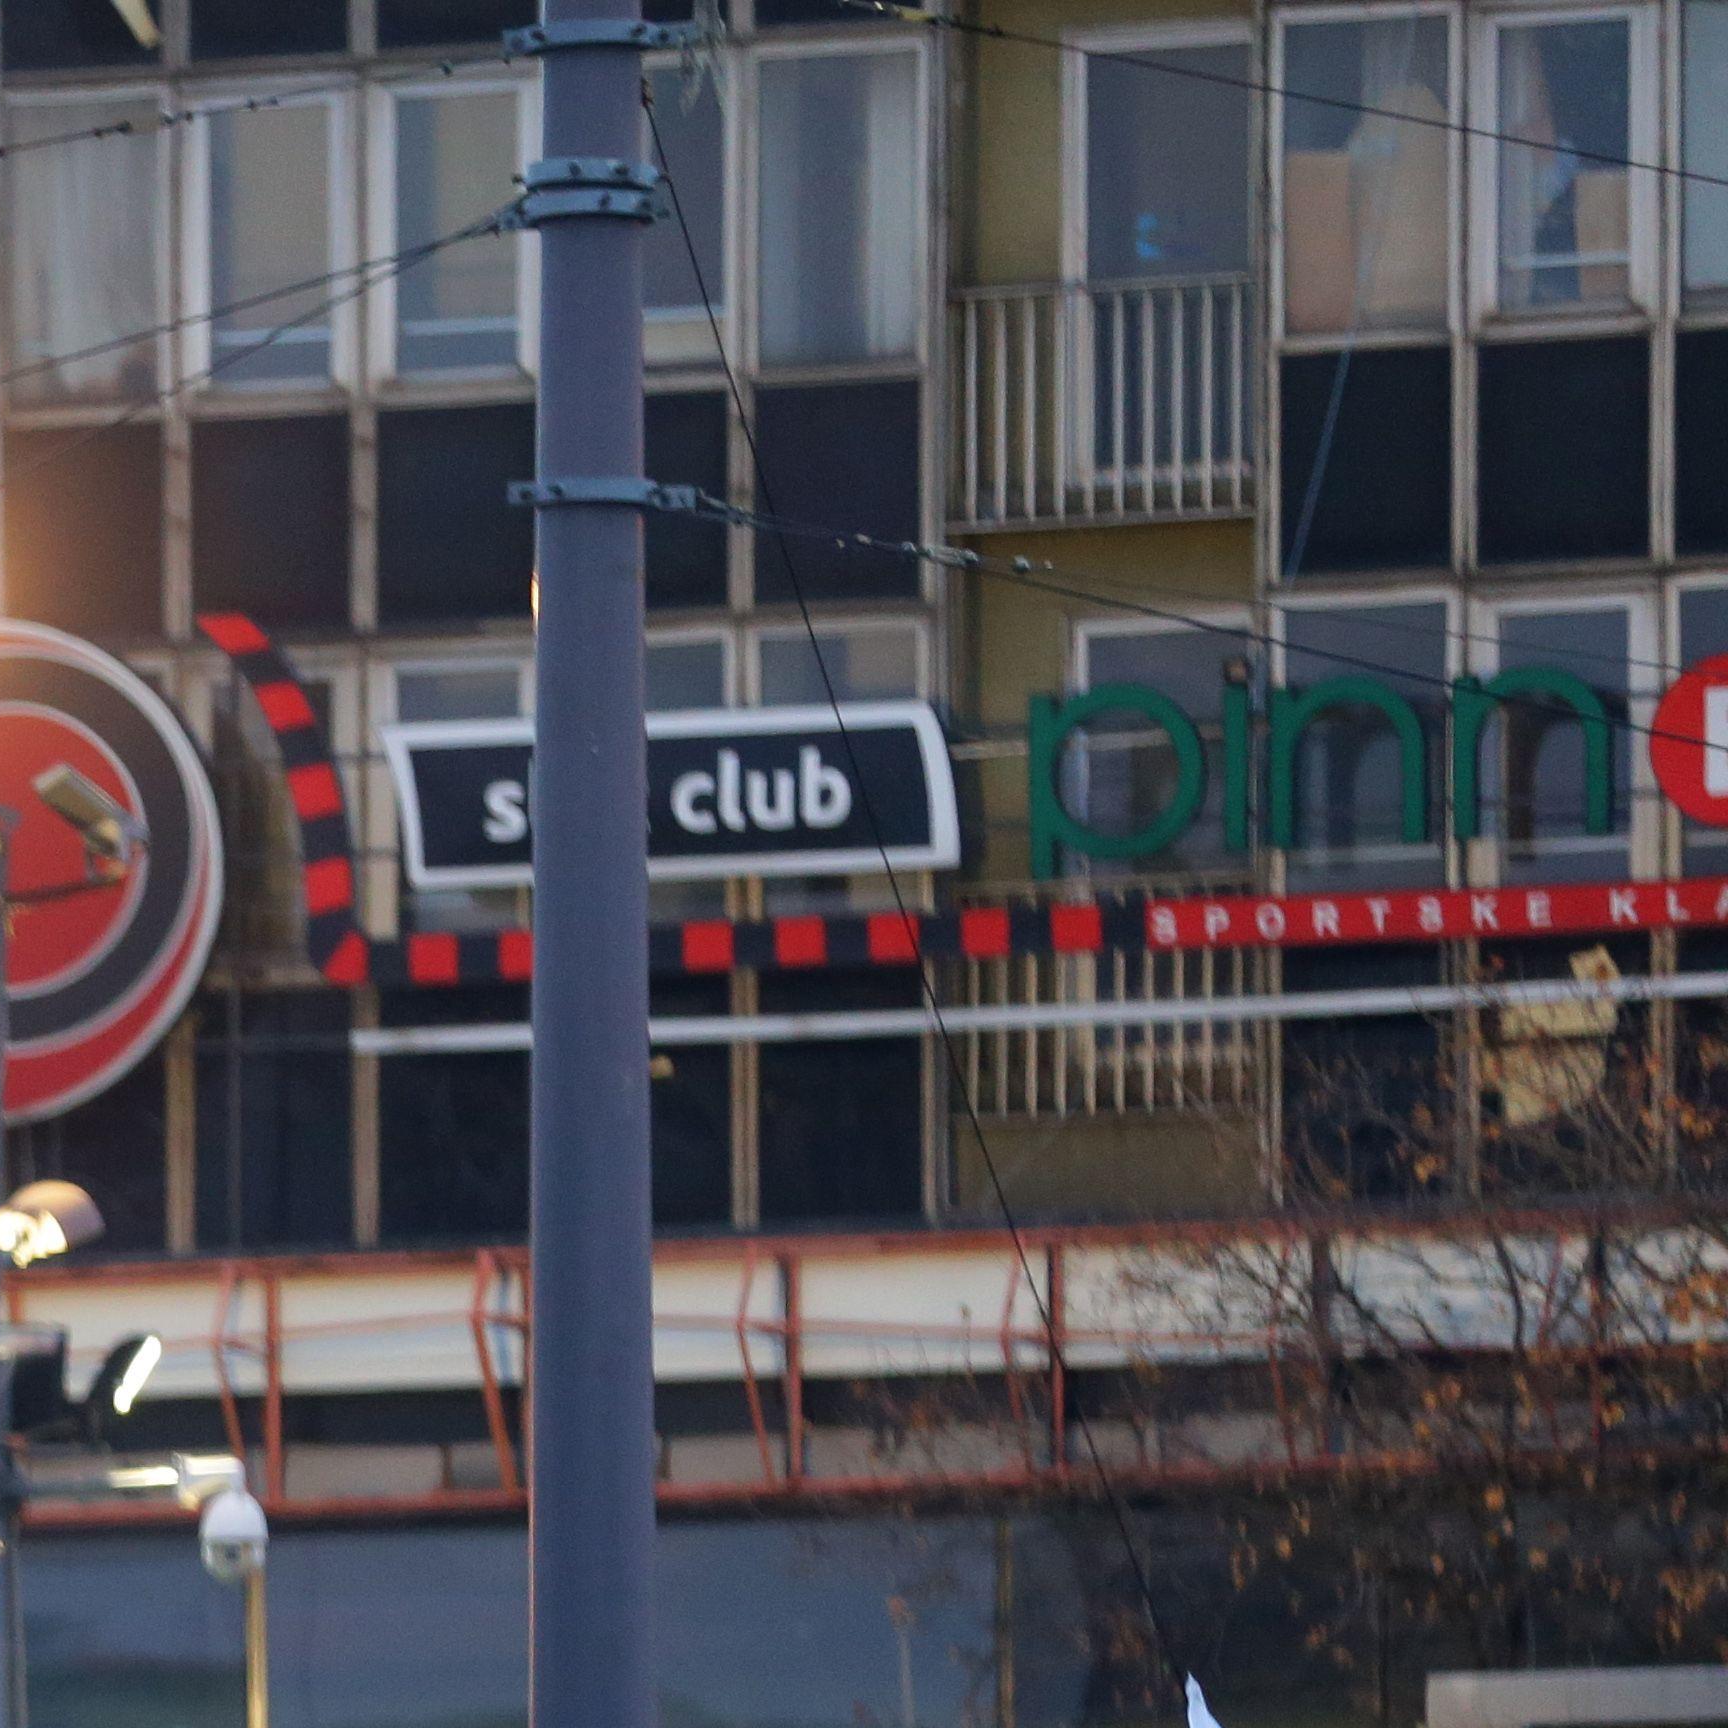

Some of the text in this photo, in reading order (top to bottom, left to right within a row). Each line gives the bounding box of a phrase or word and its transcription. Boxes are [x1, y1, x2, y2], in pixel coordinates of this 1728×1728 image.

[670, 743, 852, 836] club
[1029, 664, 1728, 882] pinn
[1150, 892, 1554, 946] SPORTSKE
